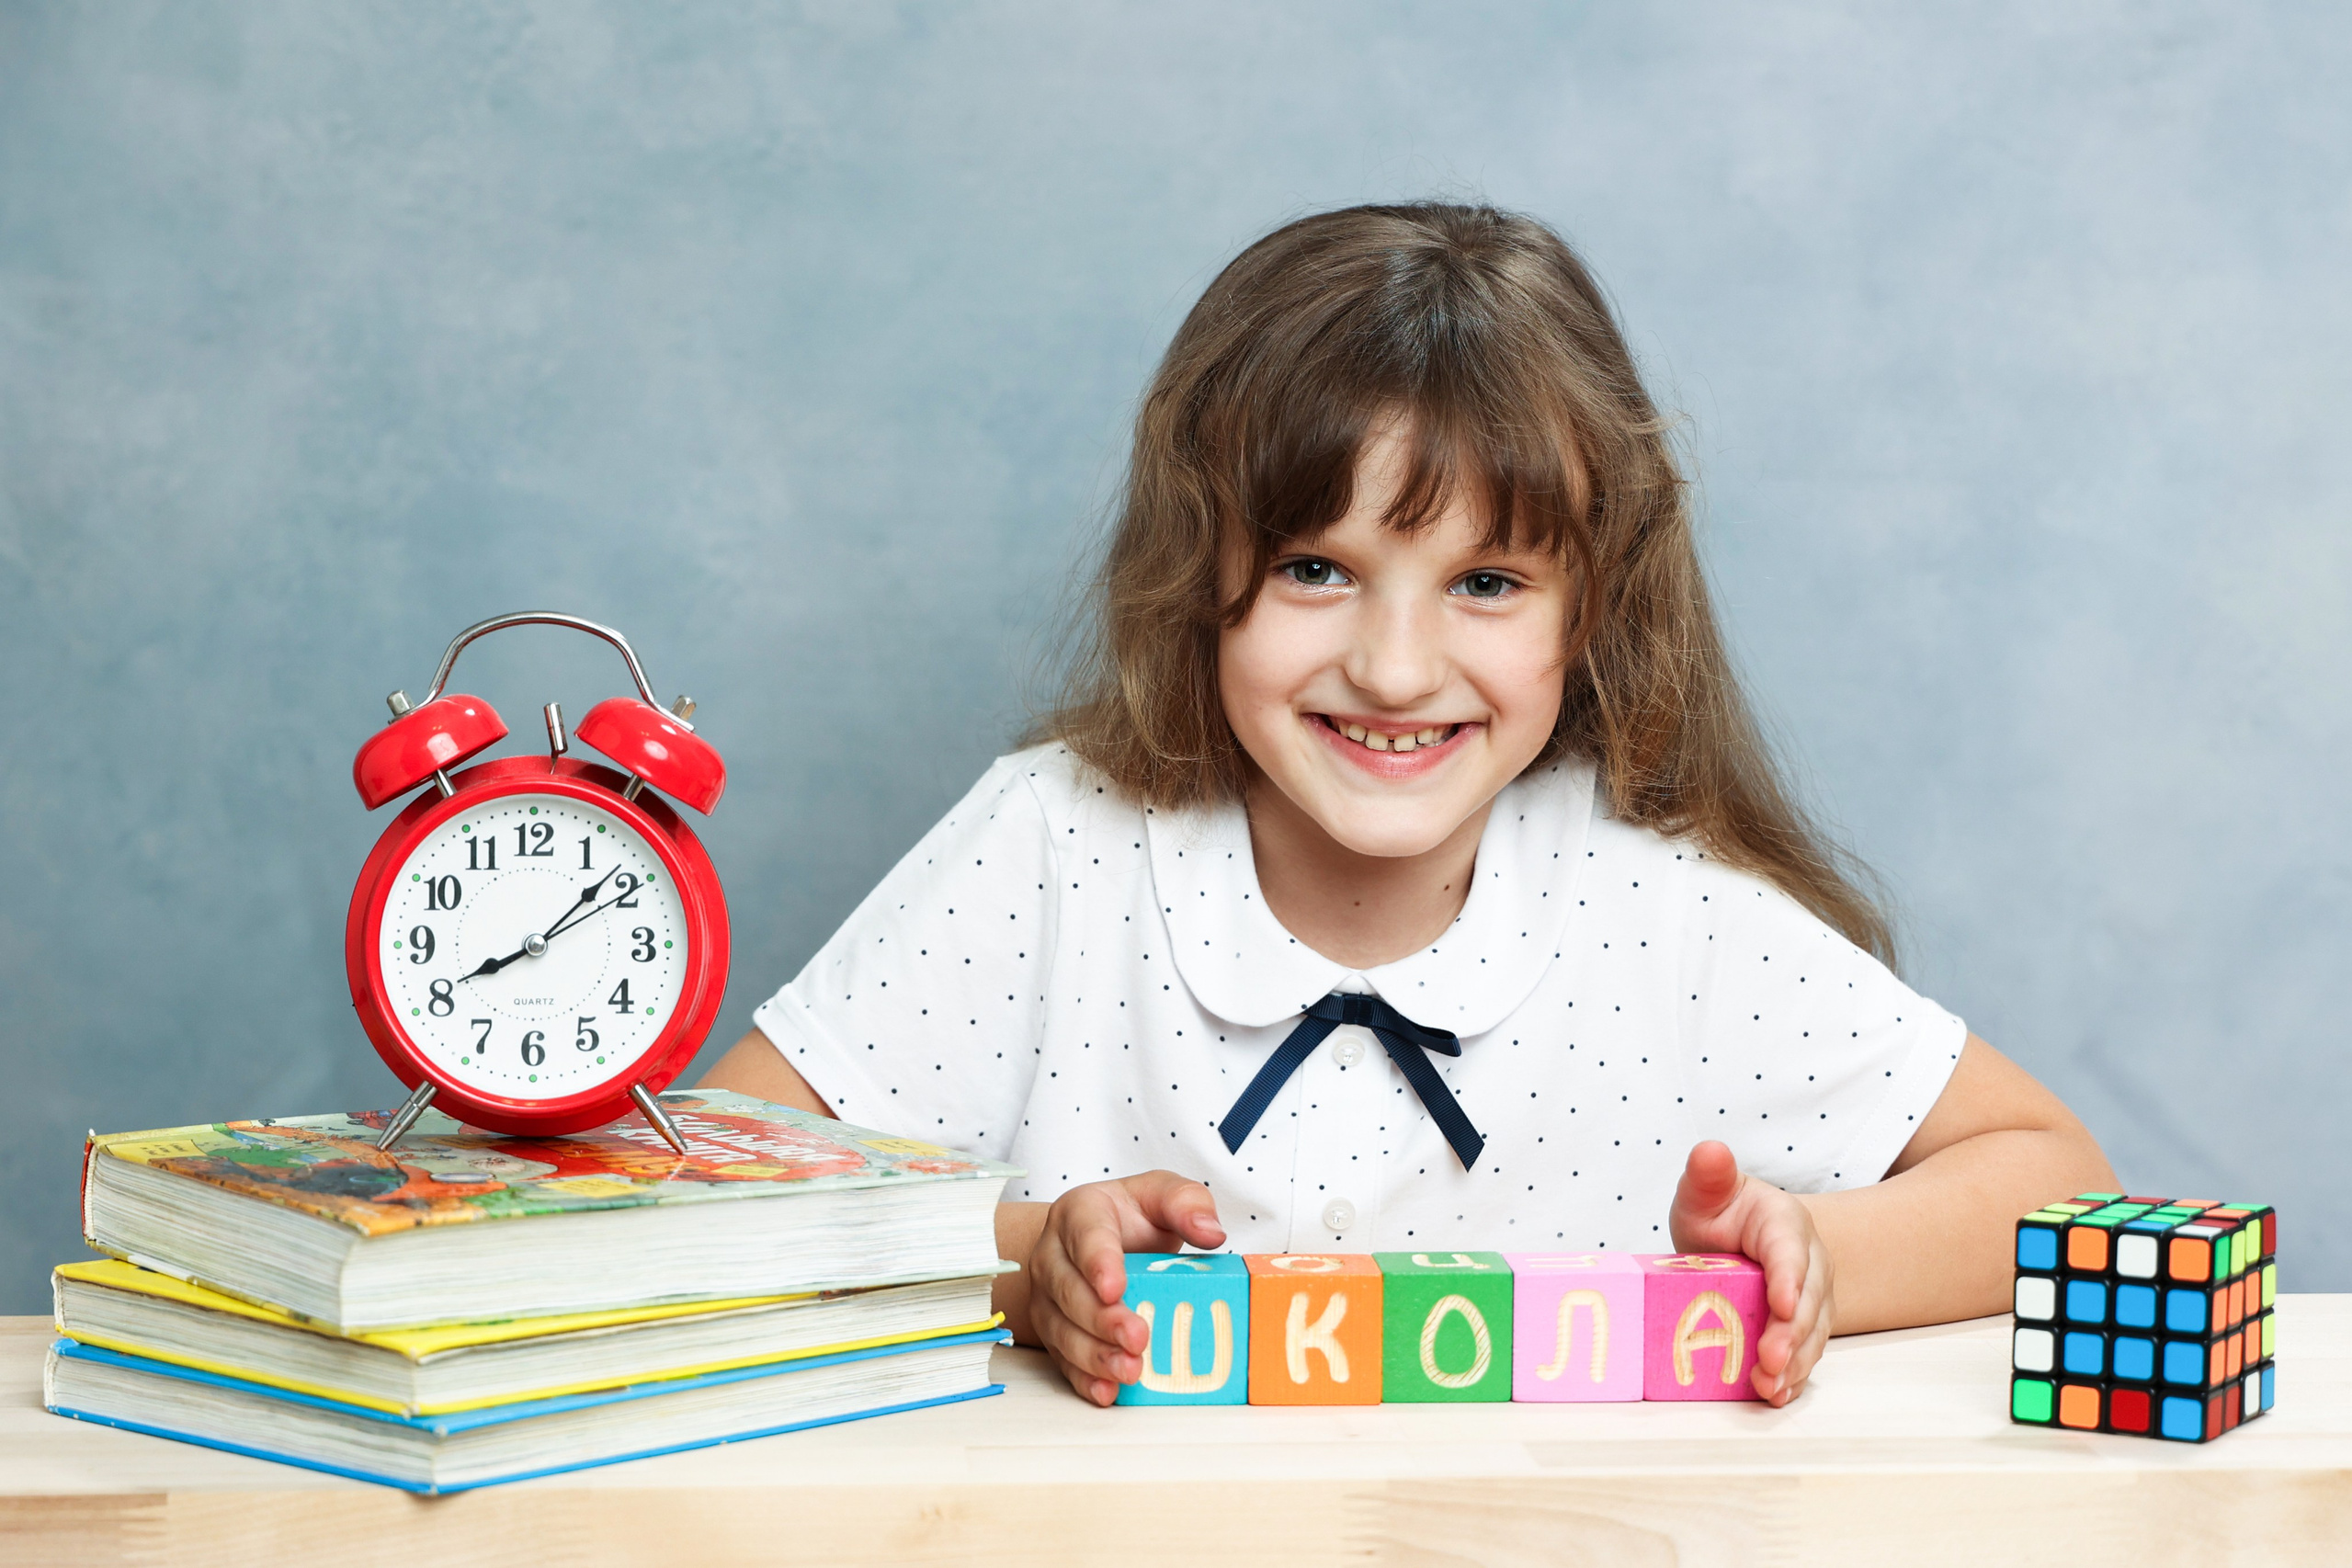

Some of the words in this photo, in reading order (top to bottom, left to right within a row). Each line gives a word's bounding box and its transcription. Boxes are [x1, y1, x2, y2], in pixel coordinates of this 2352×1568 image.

[464, 835, 500, 870] 11
[513, 822, 555, 857] 12
[578, 835, 595, 870] 1
[424, 874, 462, 911] 10
[615, 872, 638, 908] 2
[409, 925, 436, 965] 9
[631, 926, 657, 963] 3
[427, 978, 455, 1017] 8
[608, 978, 635, 1014] 4
[471, 1018, 493, 1054] 7
[520, 1030, 546, 1066] 6
[575, 1016, 600, 1052] 5
[1136, 1290, 1744, 1393] ШКОЛА
